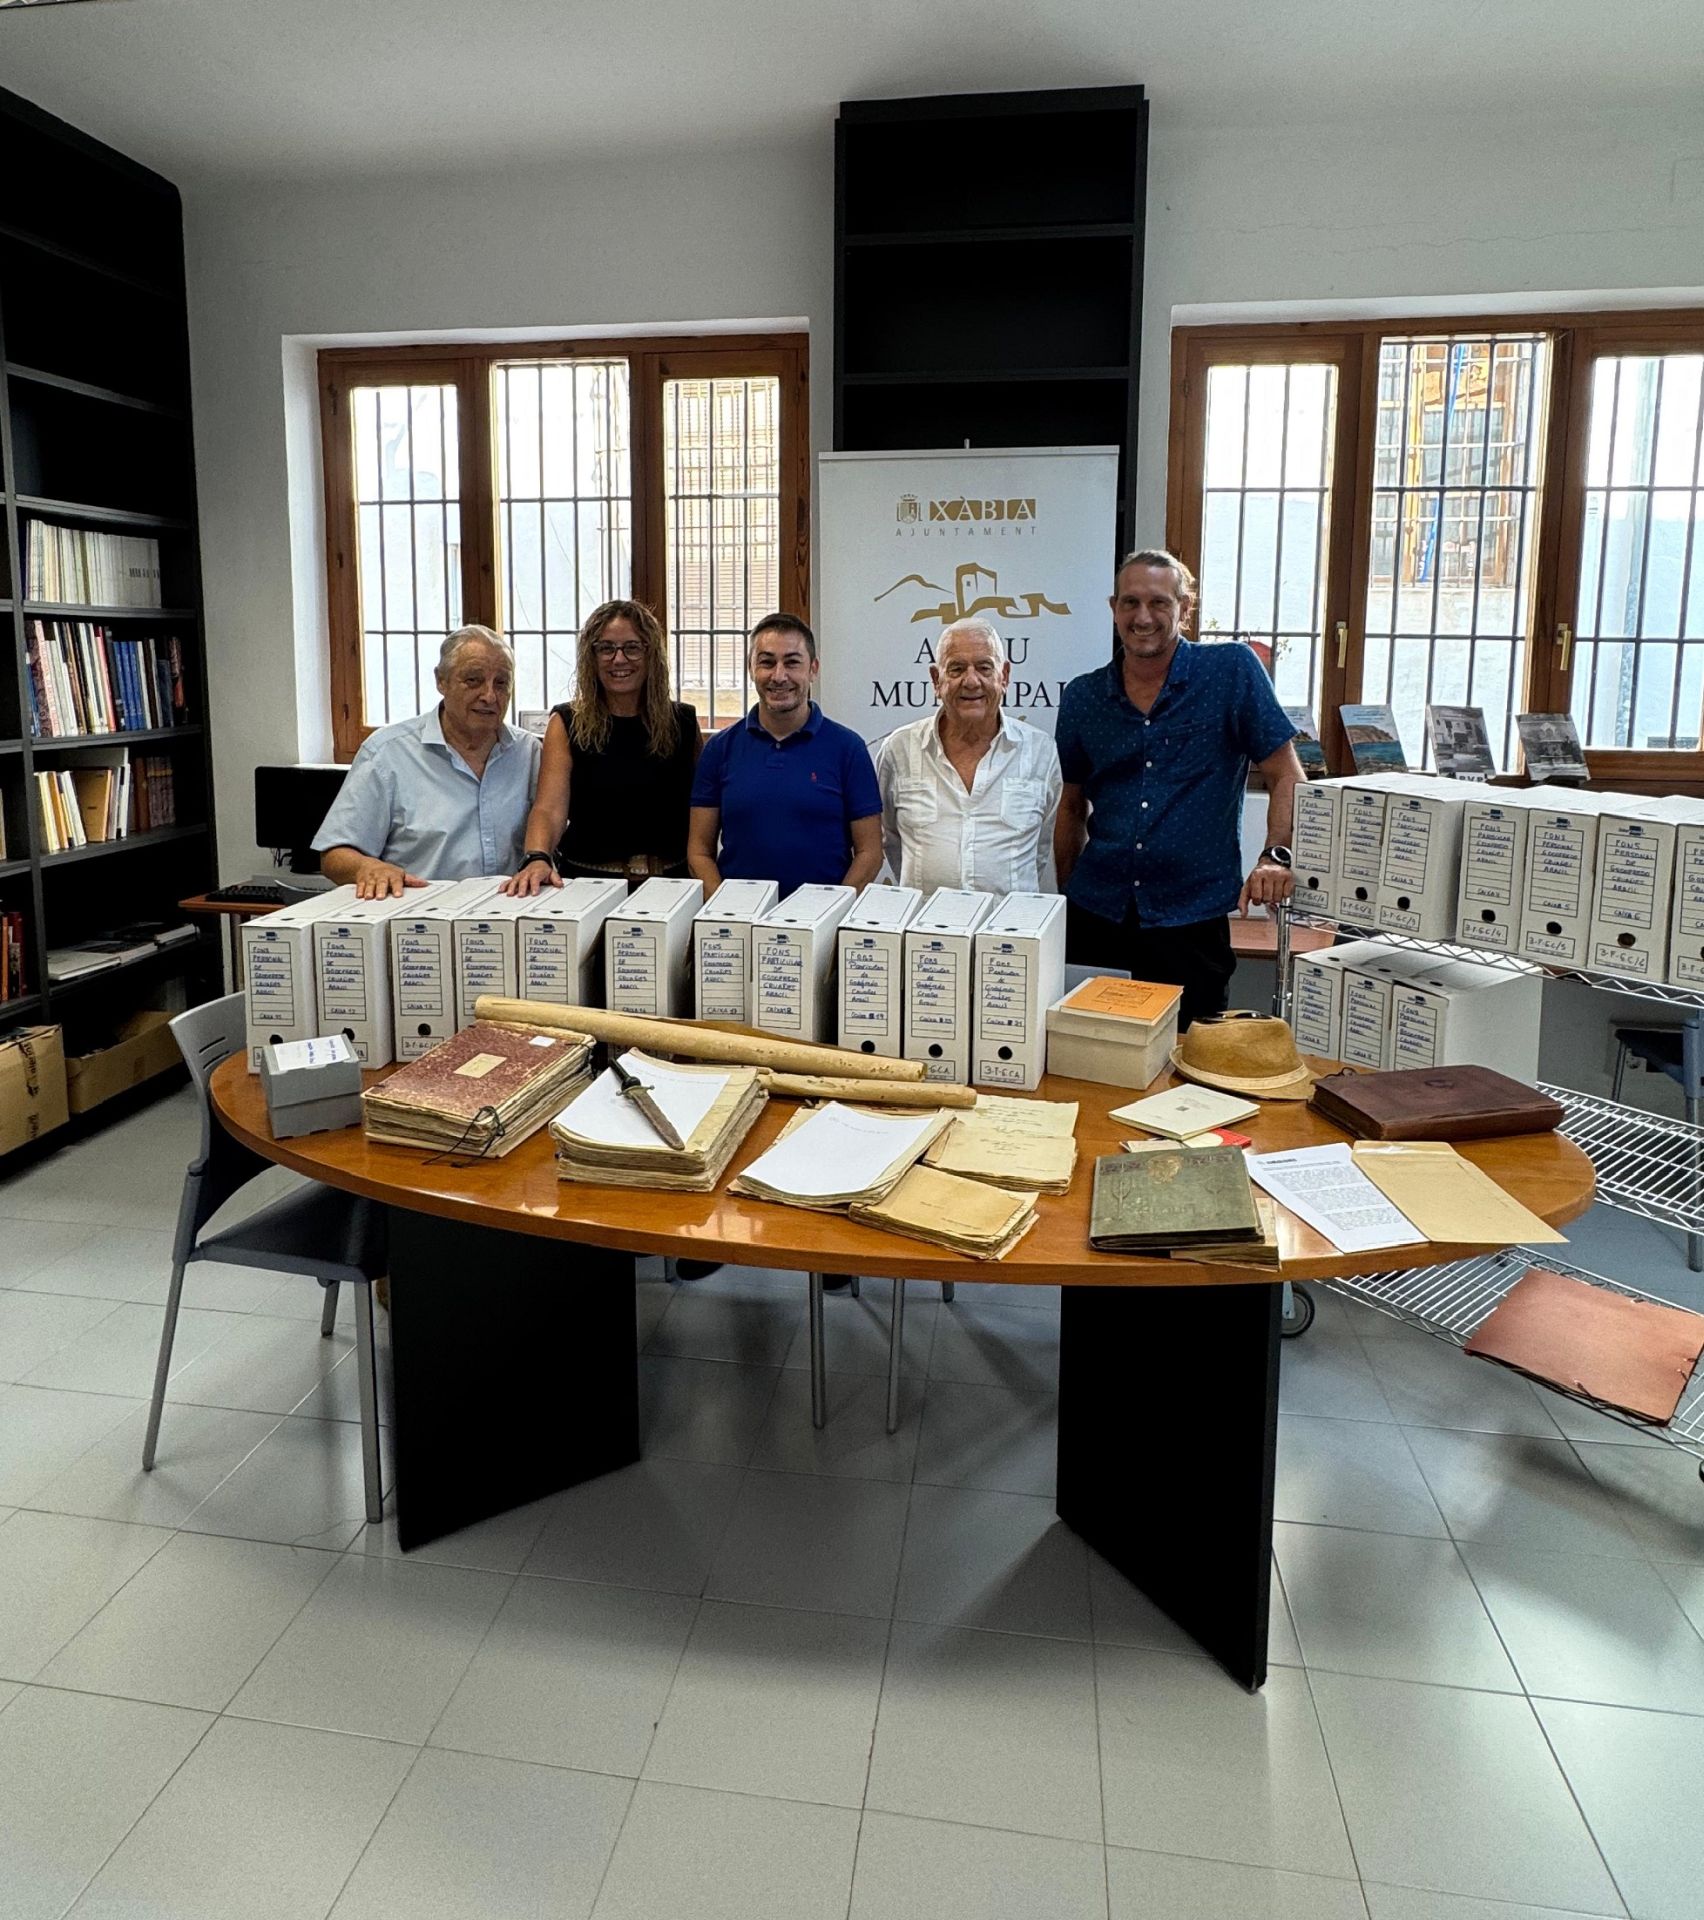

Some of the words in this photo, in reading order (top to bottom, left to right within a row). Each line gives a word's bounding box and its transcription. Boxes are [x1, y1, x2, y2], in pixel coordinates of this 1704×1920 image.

[929, 496, 1036, 522] XÀBIA
[896, 526, 1037, 536] AJUNTAMENT
[1616, 839, 1640, 850] FONS
[766, 947, 790, 956] FONS
